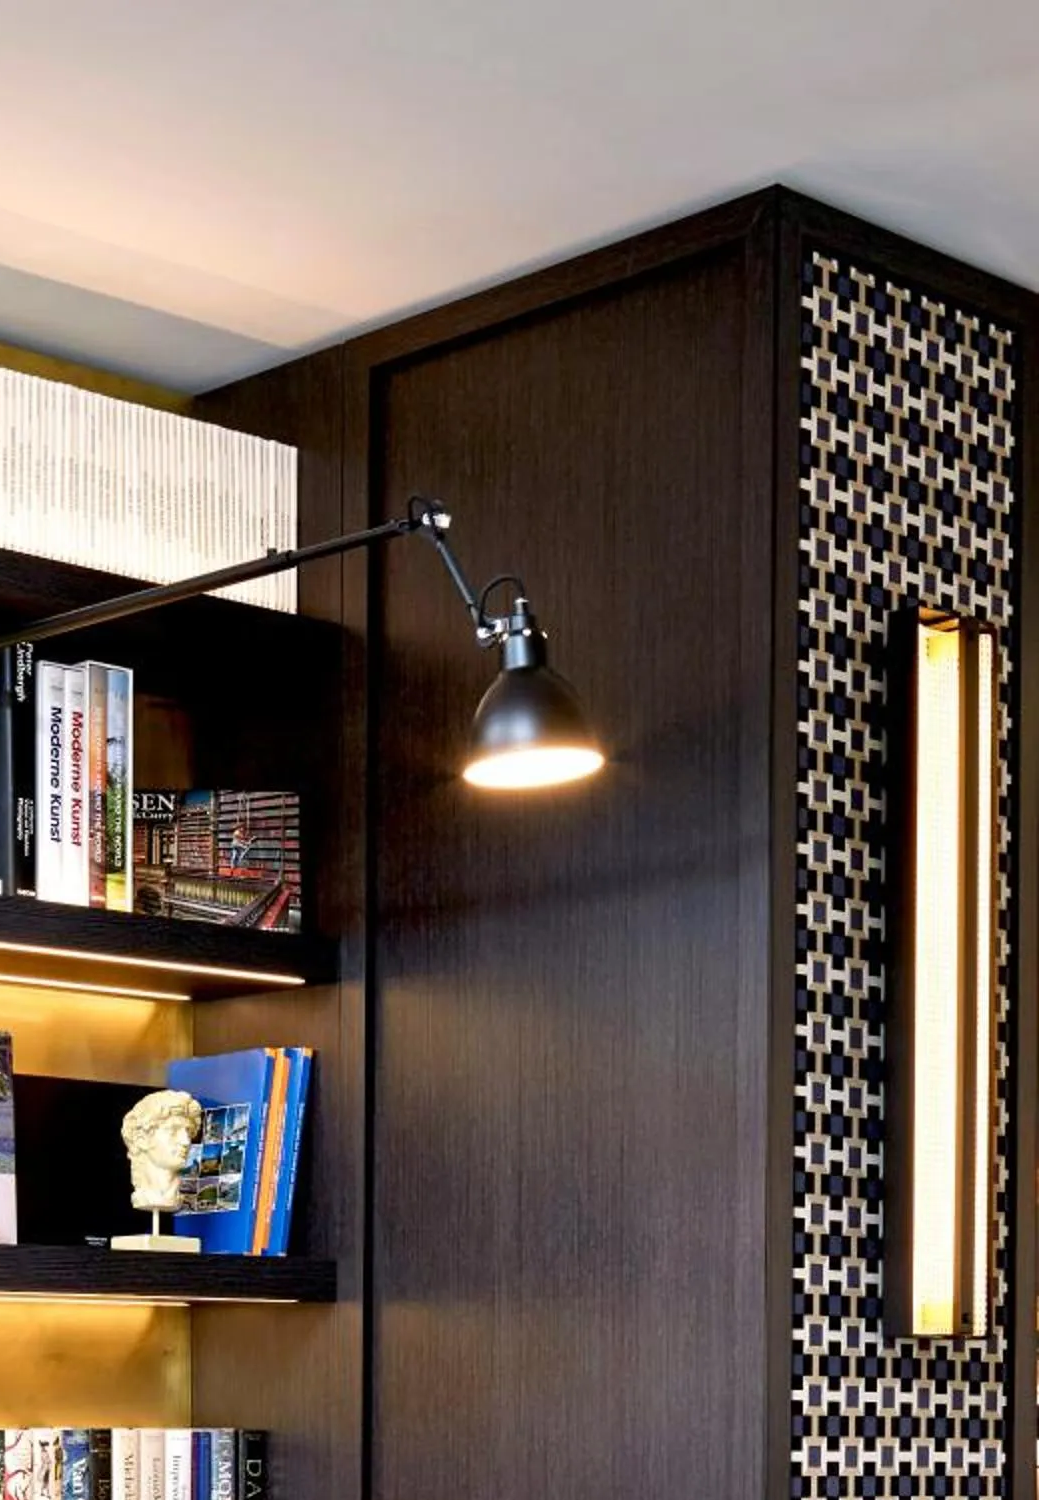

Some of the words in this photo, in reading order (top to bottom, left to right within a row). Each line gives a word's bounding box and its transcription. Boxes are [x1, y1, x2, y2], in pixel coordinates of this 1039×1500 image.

[50, 706, 62, 789] Moderne
[71, 711, 84, 791] Moderne
[50, 794, 62, 843] Kunst
[71, 799, 82, 847] Kunst
[72, 1457, 88, 1494] Van
